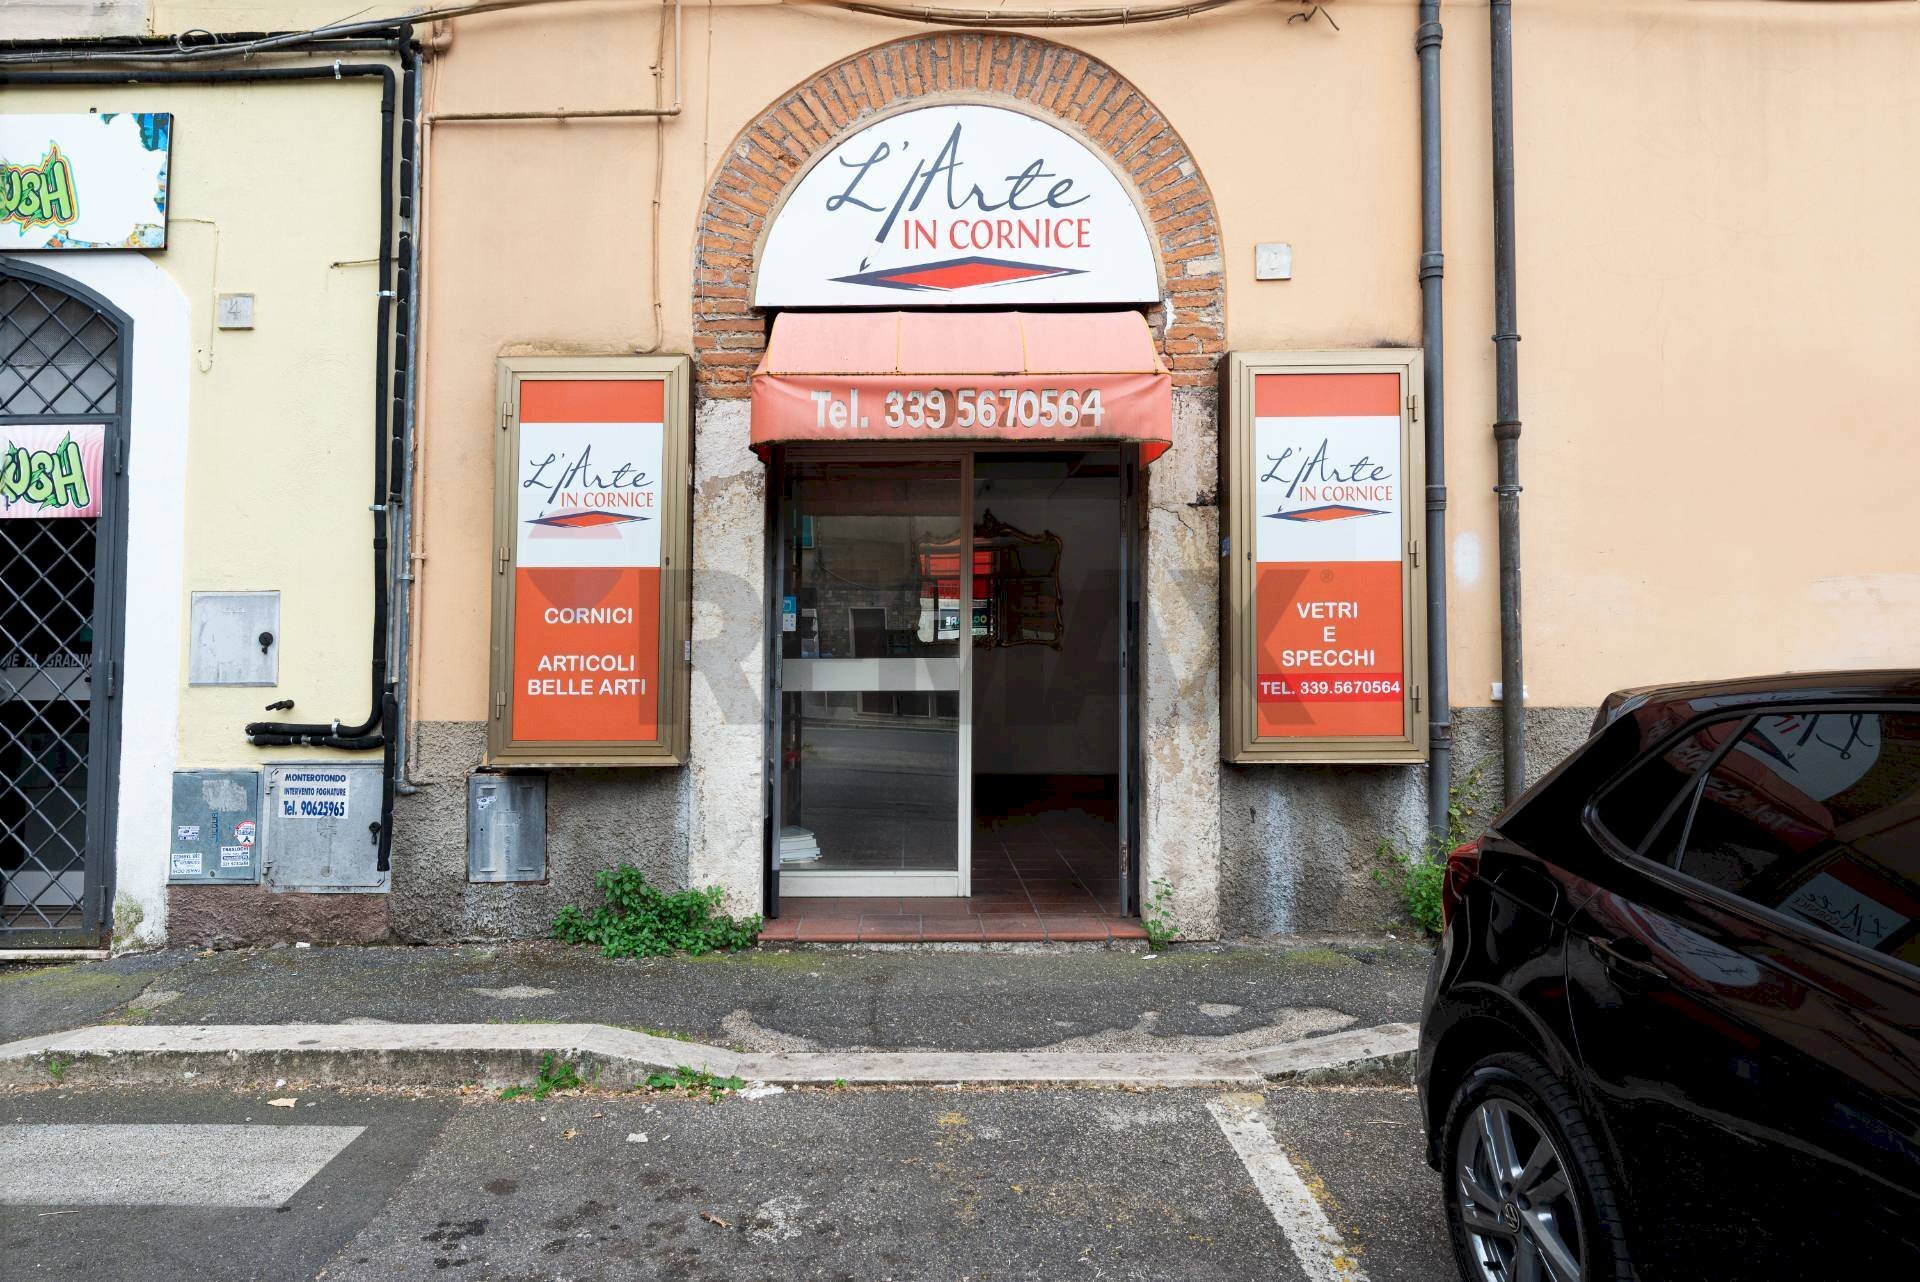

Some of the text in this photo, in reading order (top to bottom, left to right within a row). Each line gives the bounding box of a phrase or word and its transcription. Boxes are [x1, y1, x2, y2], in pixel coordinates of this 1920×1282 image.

[826, 121, 1091, 243] L'Arte
[903, 218, 1091, 249] IN CORNICE
[810, 388, 1105, 428] Tel. 339 5670564
[523, 443, 654, 504] L'Arte
[1261, 438, 1393, 498] L'Arte
[561, 492, 654, 508] IN CORNICE
[1299, 486, 1393, 501] IN CORNICE
[544, 607, 633, 624] CORNICI
[1296, 602, 1358, 619] VETRI
[1323, 626, 1336, 642] E
[537, 655, 635, 672] ARTICOLI
[1282, 649, 1375, 667] SPECCHI
[527, 678, 646, 696] BELLE ARTI
[1260, 681, 1401, 695] TEL. 339.5670564
[284, 773, 347, 783] MONTEROTONDO
[283, 787, 347, 797] INTERVENTO FOGNATURE
[283, 800, 345, 817] Tel. 90625965
